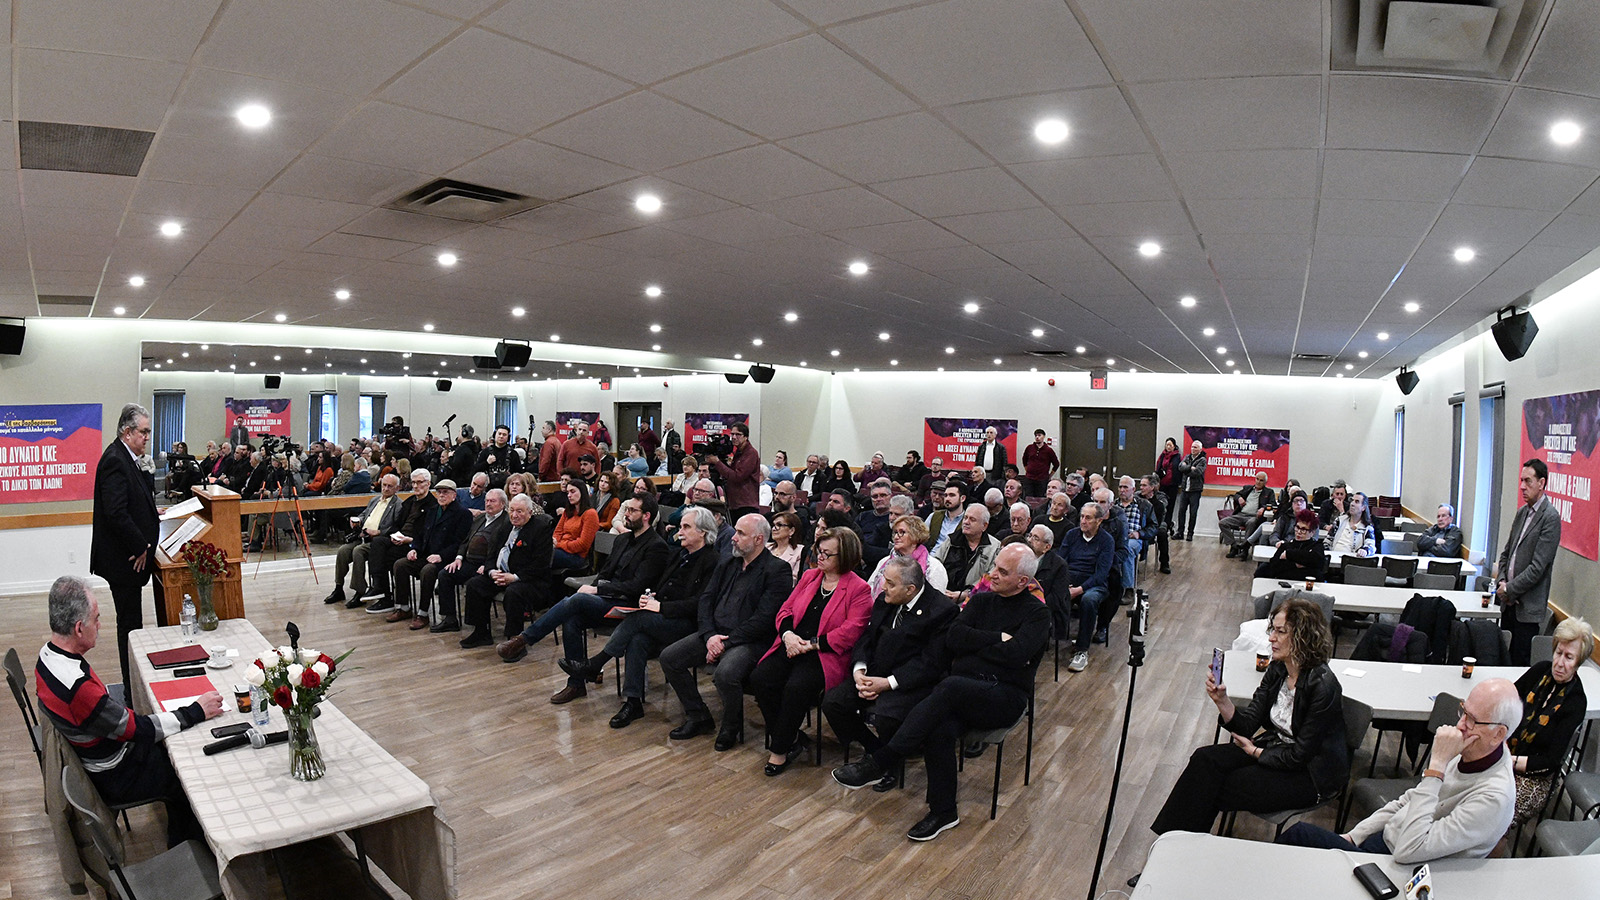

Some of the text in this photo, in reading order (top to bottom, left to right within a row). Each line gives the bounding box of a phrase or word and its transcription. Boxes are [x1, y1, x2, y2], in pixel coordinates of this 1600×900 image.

[9, 445, 40, 463] ΔΥΝΑΤΟ
[41, 445, 57, 462] ΚΚΕ
[21, 464, 45, 476] ΑΓΩΝΕΣ
[45, 462, 87, 476] ΑΝΤΕΠΙΘΕΣΗΣ
[1207, 456, 1224, 466] ΔΩΣΕΙ
[1224, 457, 1249, 467] ΔΥΝΑΜΗ
[1255, 459, 1275, 469] ΕΛΠΙΔΑ
[1216, 467, 1231, 475] ΣΤΟΝ
[1, 480, 10, 491] ΤΟ
[11, 479, 28, 491] ΔΙΚΙΟ
[29, 478, 42, 490] ΤΩΝ
